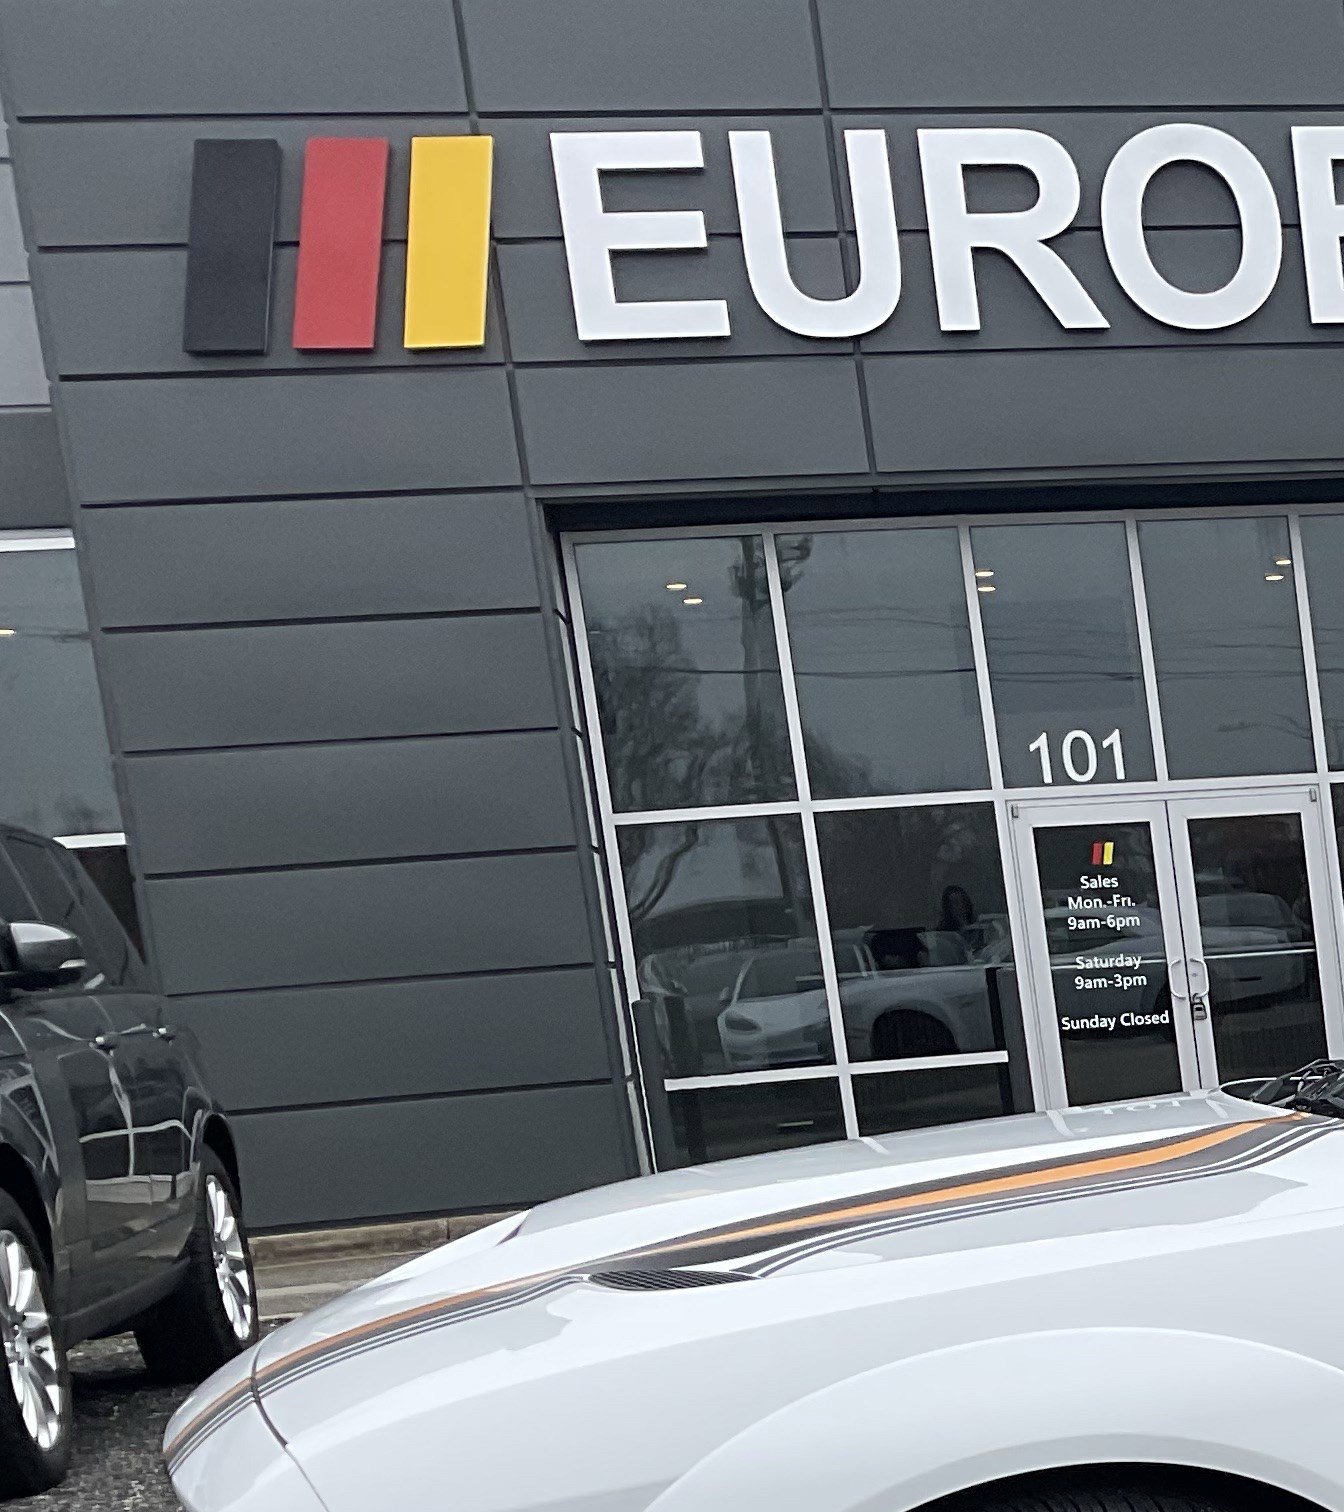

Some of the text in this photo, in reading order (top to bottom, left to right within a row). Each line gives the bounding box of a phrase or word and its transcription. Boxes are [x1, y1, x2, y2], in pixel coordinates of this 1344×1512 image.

[1029, 728, 1126, 784] 101
[1080, 875, 1119, 889] Sales
[1067, 894, 1136, 910] Mon.-Fri.
[1067, 915, 1140, 931] 9am-6pm
[1075, 954, 1141, 970] Saturday
[1074, 974, 1147, 990] 9am-3pm
[1061, 1010, 1170, 1031] Sunday Closed
